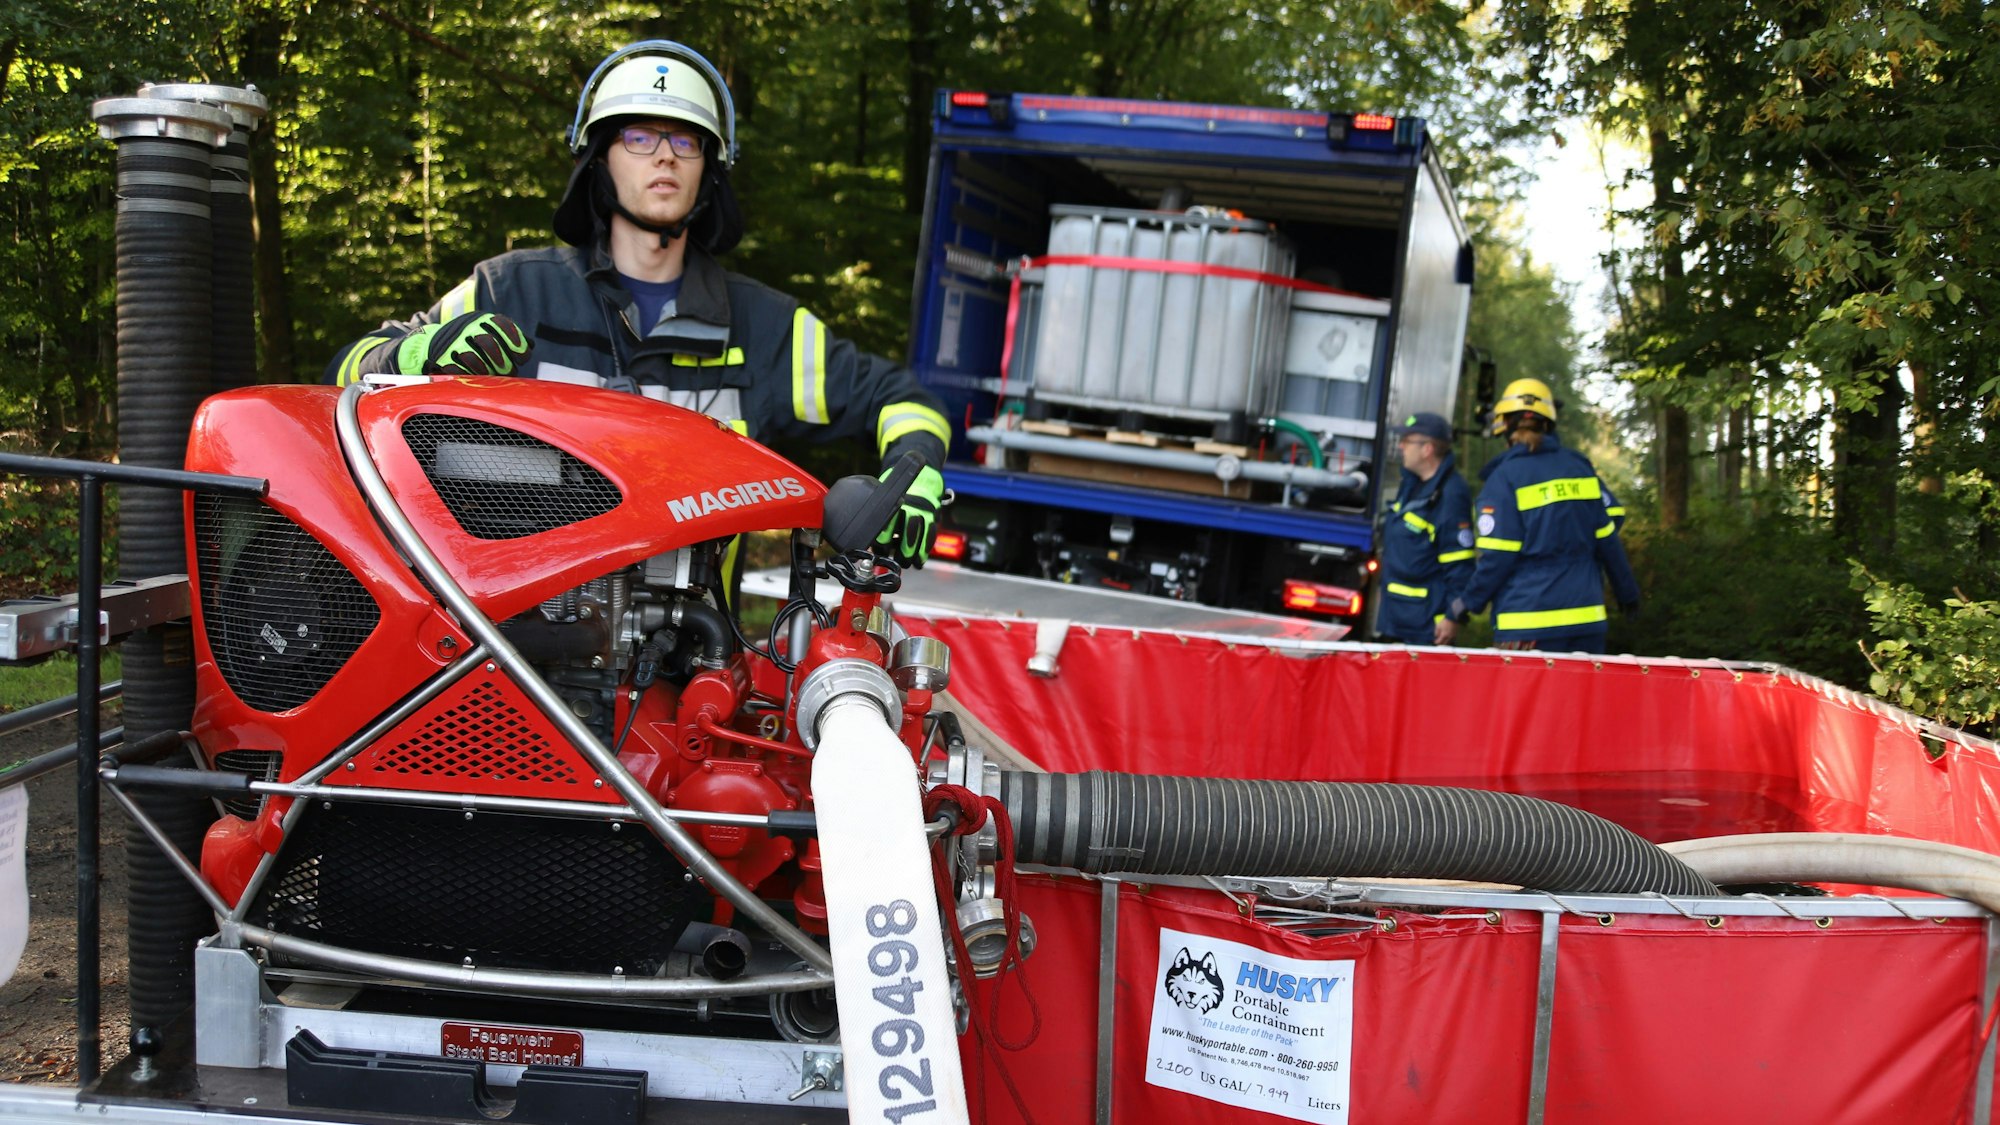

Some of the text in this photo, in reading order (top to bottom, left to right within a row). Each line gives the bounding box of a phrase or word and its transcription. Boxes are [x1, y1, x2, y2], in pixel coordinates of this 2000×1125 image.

[653, 76, 667, 93] 4
[666, 477, 806, 523] MAGIRUS
[1539, 483, 1580, 500] THW
[1235, 961, 1339, 1003] HUSKY
[865, 899, 937, 1125] 129498
[1233, 989, 1290, 1017] Portable
[1220, 1021, 1249, 1035] Leader
[1251, 1028, 1261, 1038] of
[1261, 1030, 1274, 1041] the
[1232, 1005, 1325, 1038] Containment
[469, 1027, 554, 1048] Feuerwehr
[1161, 1026, 1340, 1072] www.huskyportable.com 800-260-9950
[445, 1043, 577, 1067] Stadt Bad Honnef
[1187, 1046, 1197, 1054] US
[1197, 1049, 1217, 1060] Patent
[1218, 1055, 1229, 1064] No.
[1262, 1064, 1275, 1073] and
[1200, 1071, 1216, 1085] US
[1308, 1096, 1341, 1111] Liters
